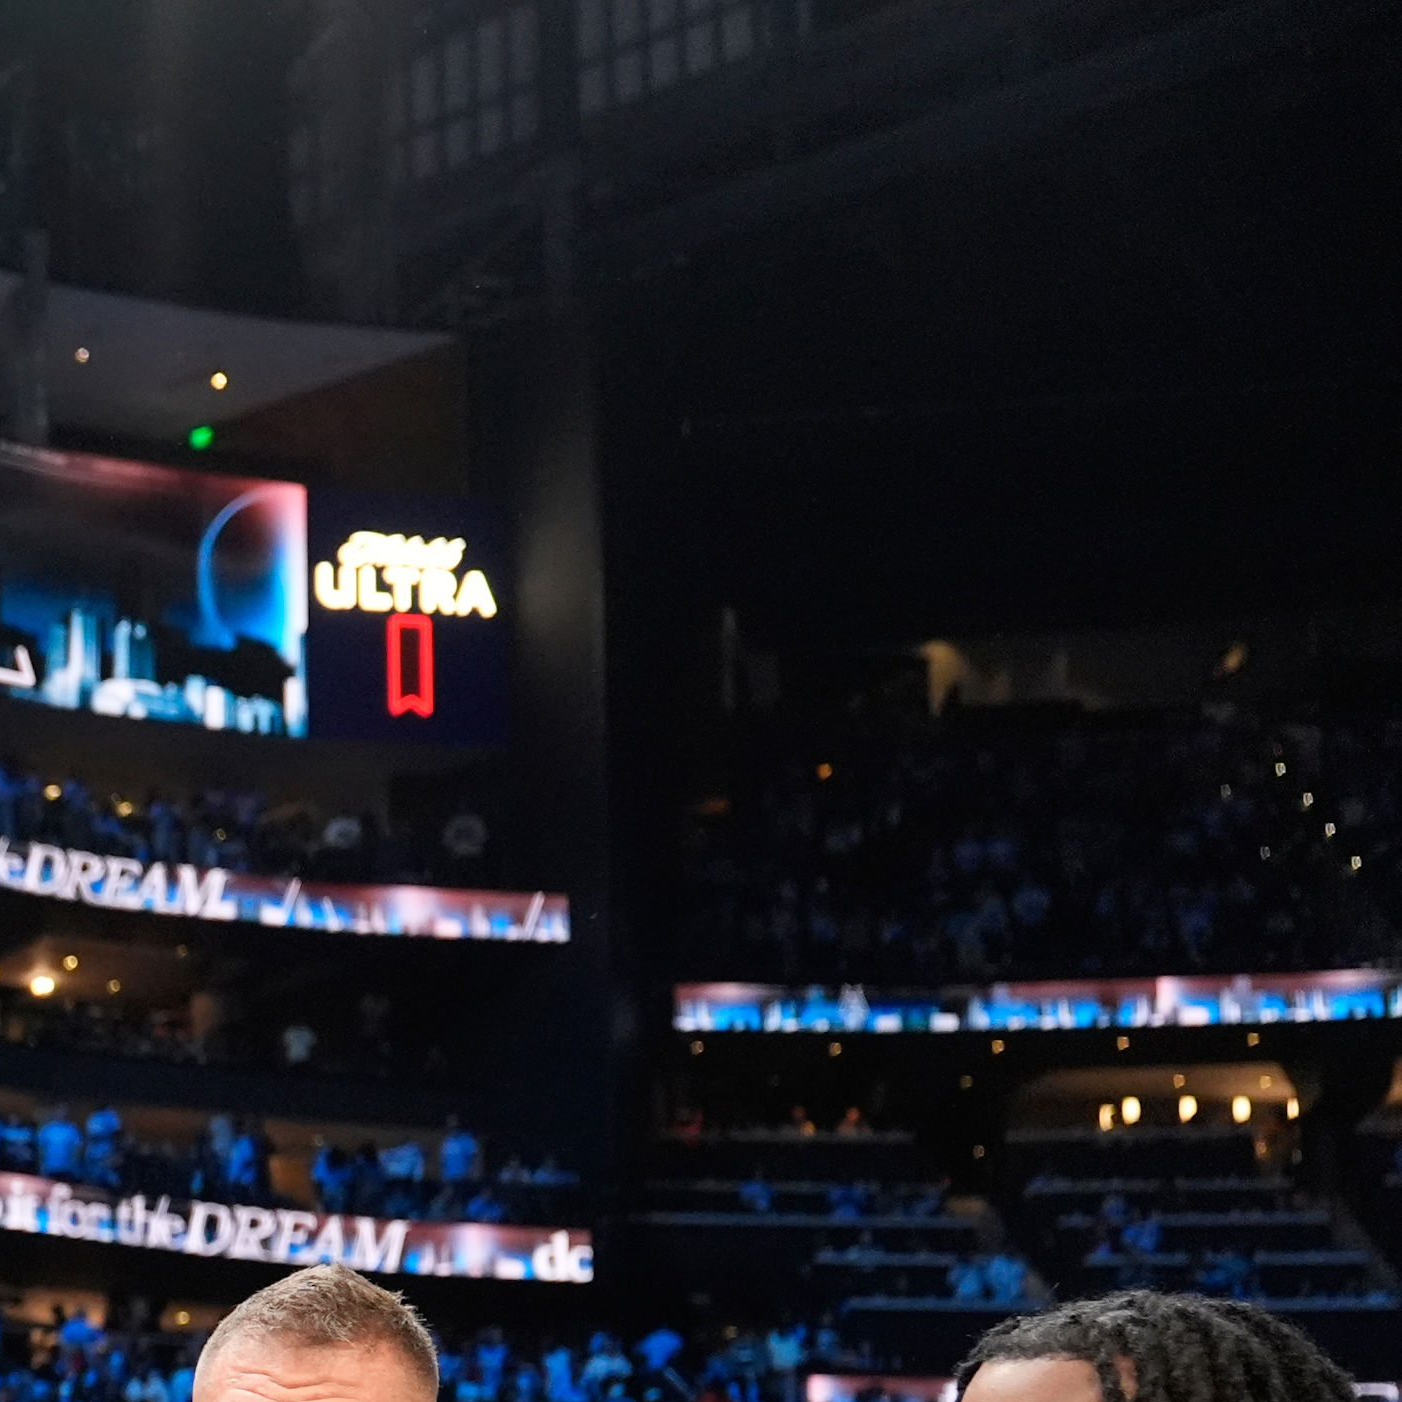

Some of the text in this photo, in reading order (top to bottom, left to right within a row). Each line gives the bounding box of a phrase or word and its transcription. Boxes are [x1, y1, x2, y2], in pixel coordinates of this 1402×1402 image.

[314, 561, 497, 618] ULTRA
[24, 841, 238, 921] DREAM
[47, 1182, 114, 1242] for
[116, 1194, 187, 1250] the
[184, 1200, 409, 1274] DREAM
